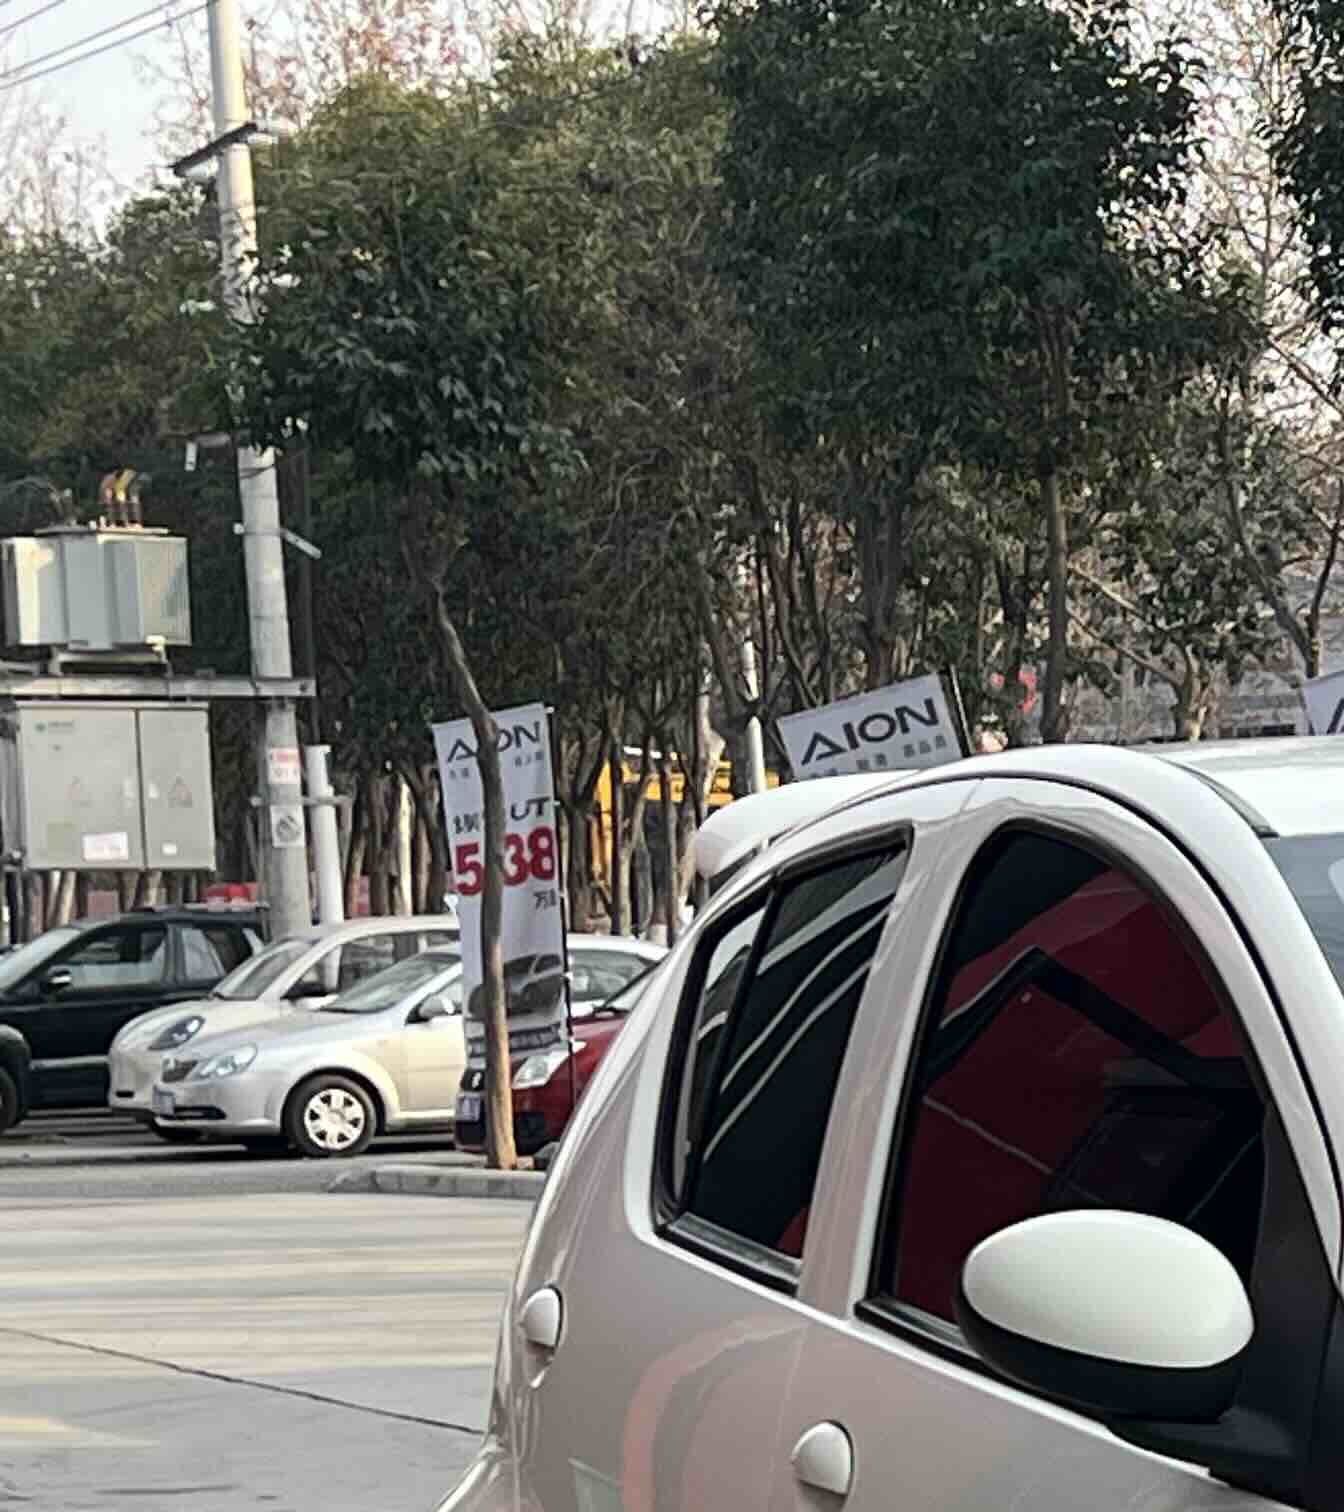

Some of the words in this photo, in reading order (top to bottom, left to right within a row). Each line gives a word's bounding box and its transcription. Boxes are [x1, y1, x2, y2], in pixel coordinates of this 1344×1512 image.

[447, 721, 540, 763] AON
[801, 696, 940, 766] AION
[510, 796, 550, 821] UT
